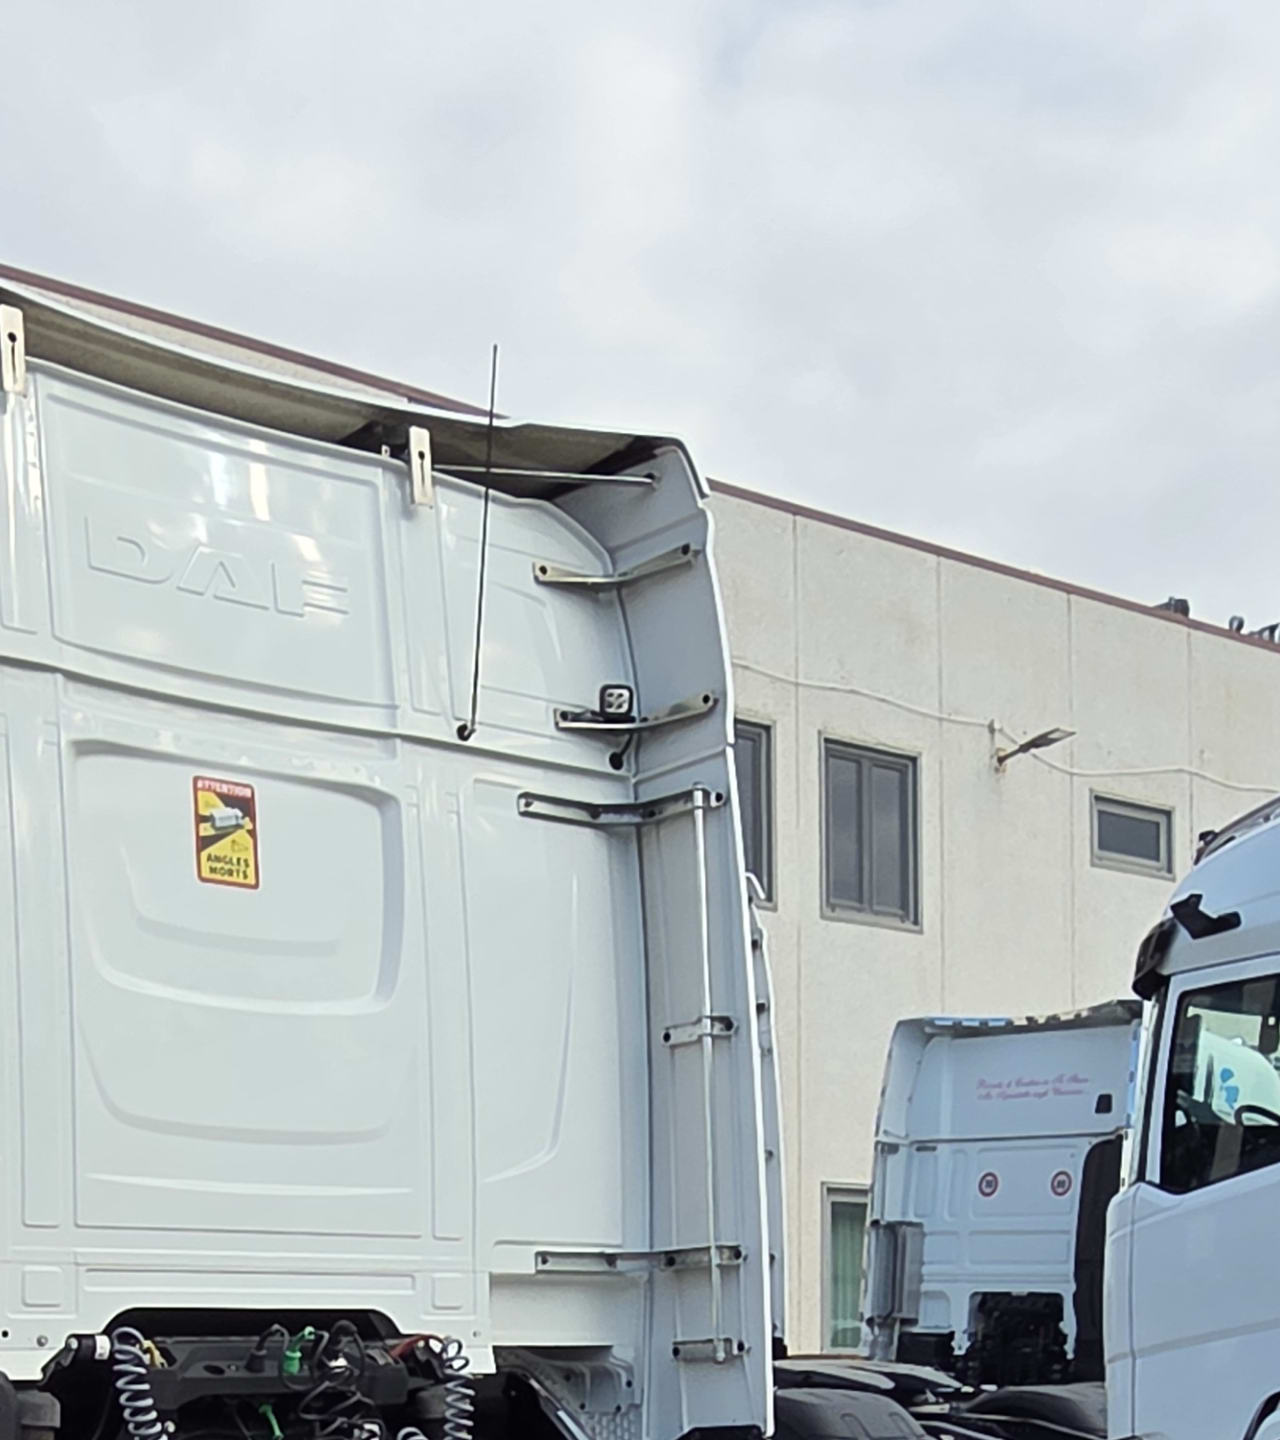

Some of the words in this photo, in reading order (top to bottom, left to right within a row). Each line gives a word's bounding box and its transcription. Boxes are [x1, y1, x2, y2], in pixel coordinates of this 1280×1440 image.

[84, 512, 350, 618] DAF
[206, 852, 251, 869] ANGLES
[208, 864, 249, 880] MORTS
